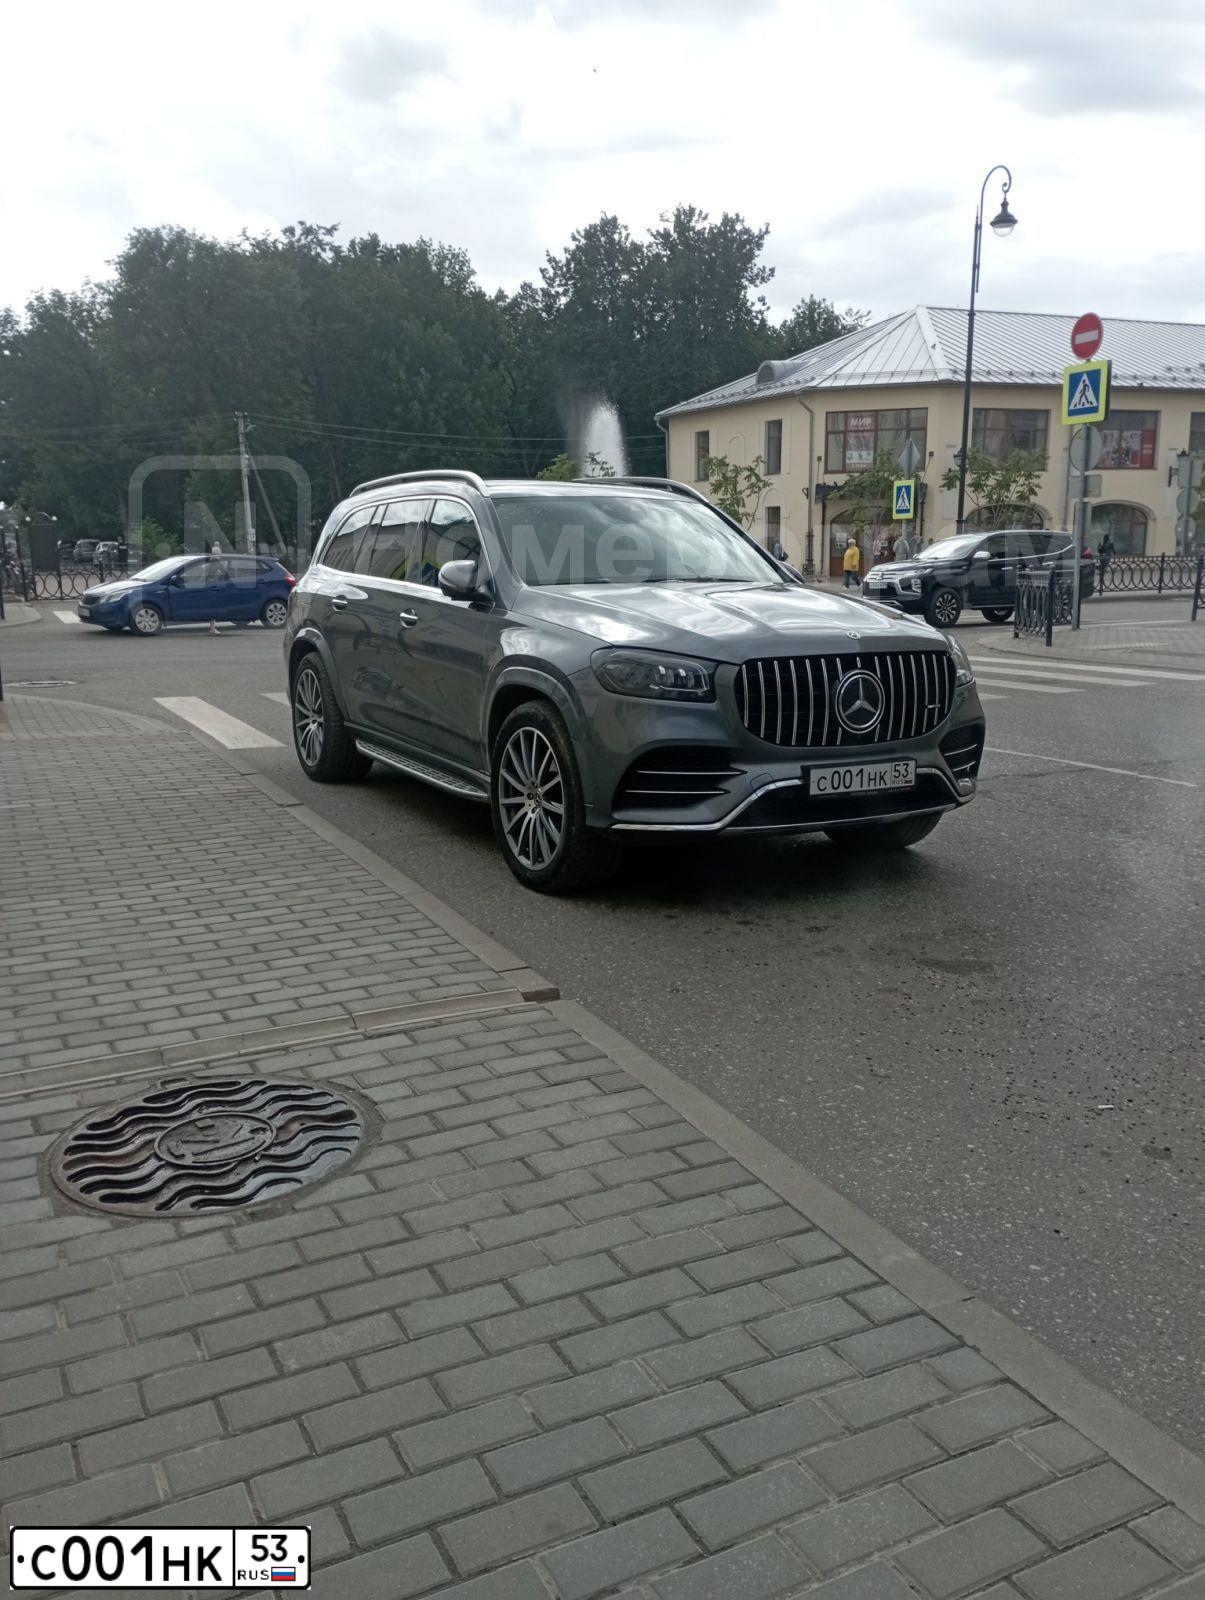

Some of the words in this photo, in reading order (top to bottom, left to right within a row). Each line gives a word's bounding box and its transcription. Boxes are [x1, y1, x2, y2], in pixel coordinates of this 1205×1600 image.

[850, 418, 872, 426] МИР
[817, 768, 887, 792] С001НК
[893, 763, 909, 779] 53
